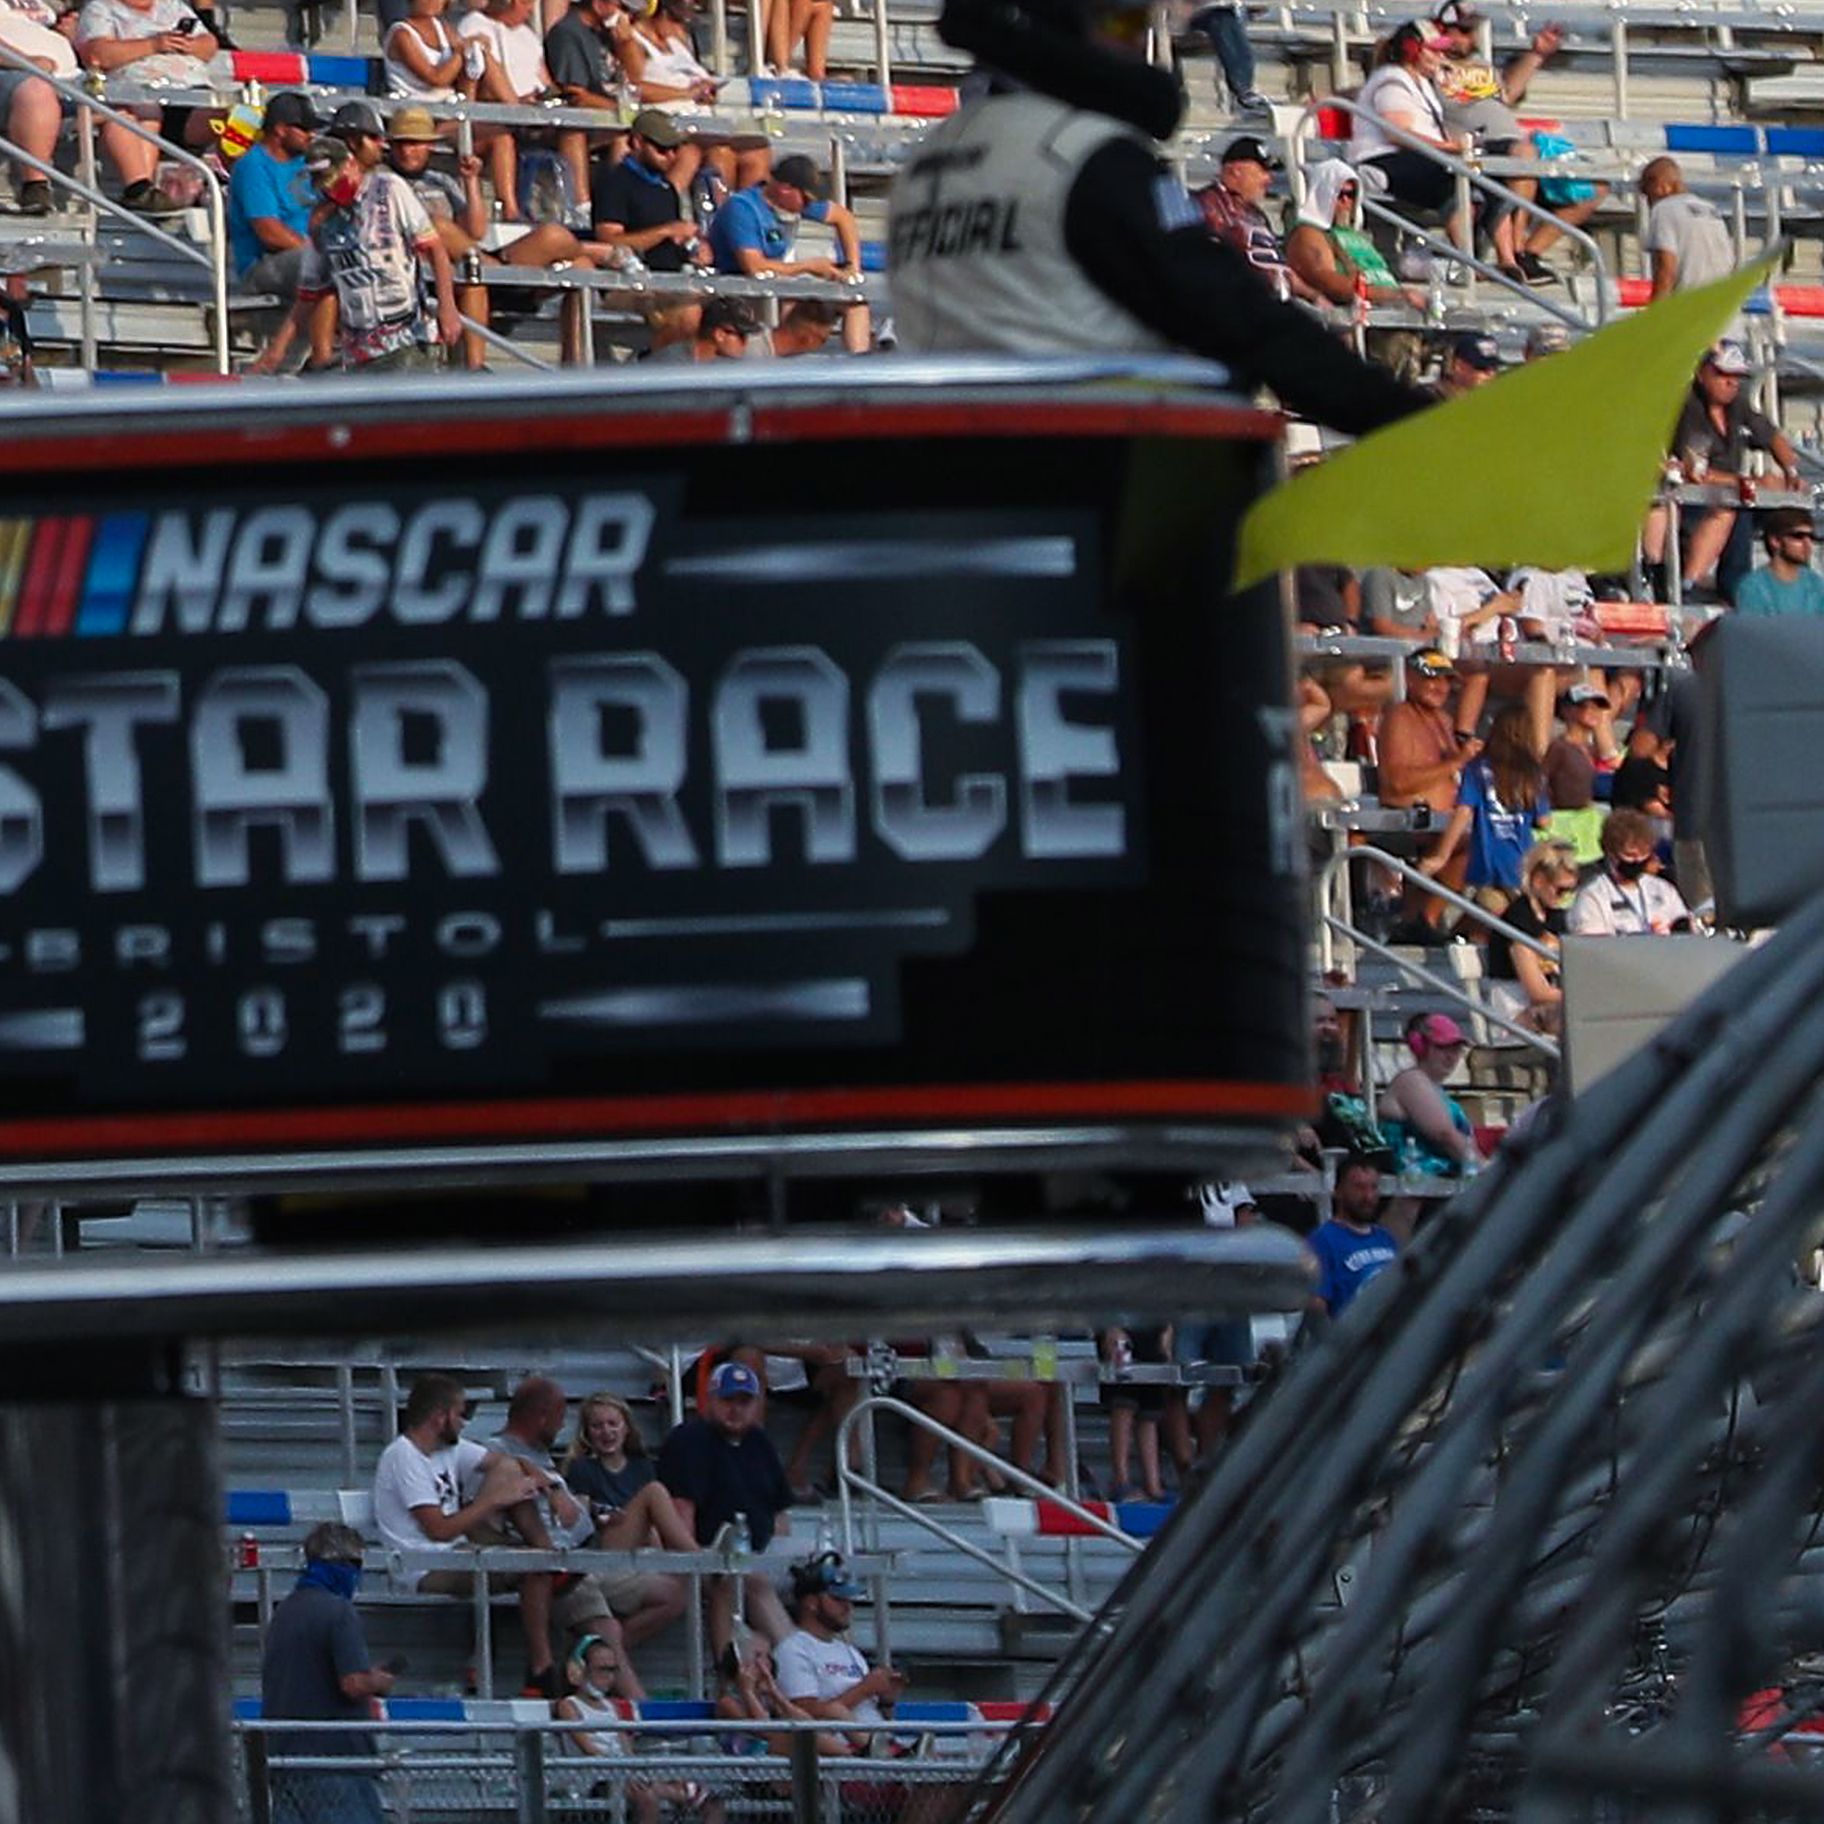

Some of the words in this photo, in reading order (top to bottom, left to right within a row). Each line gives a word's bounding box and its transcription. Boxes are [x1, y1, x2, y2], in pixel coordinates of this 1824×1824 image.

[129, 490, 655, 638] NASCAR
[549, 638, 1127, 876] RACE
[25, 908, 587, 972] BRISTOL
[137, 979, 489, 1061] 2020
